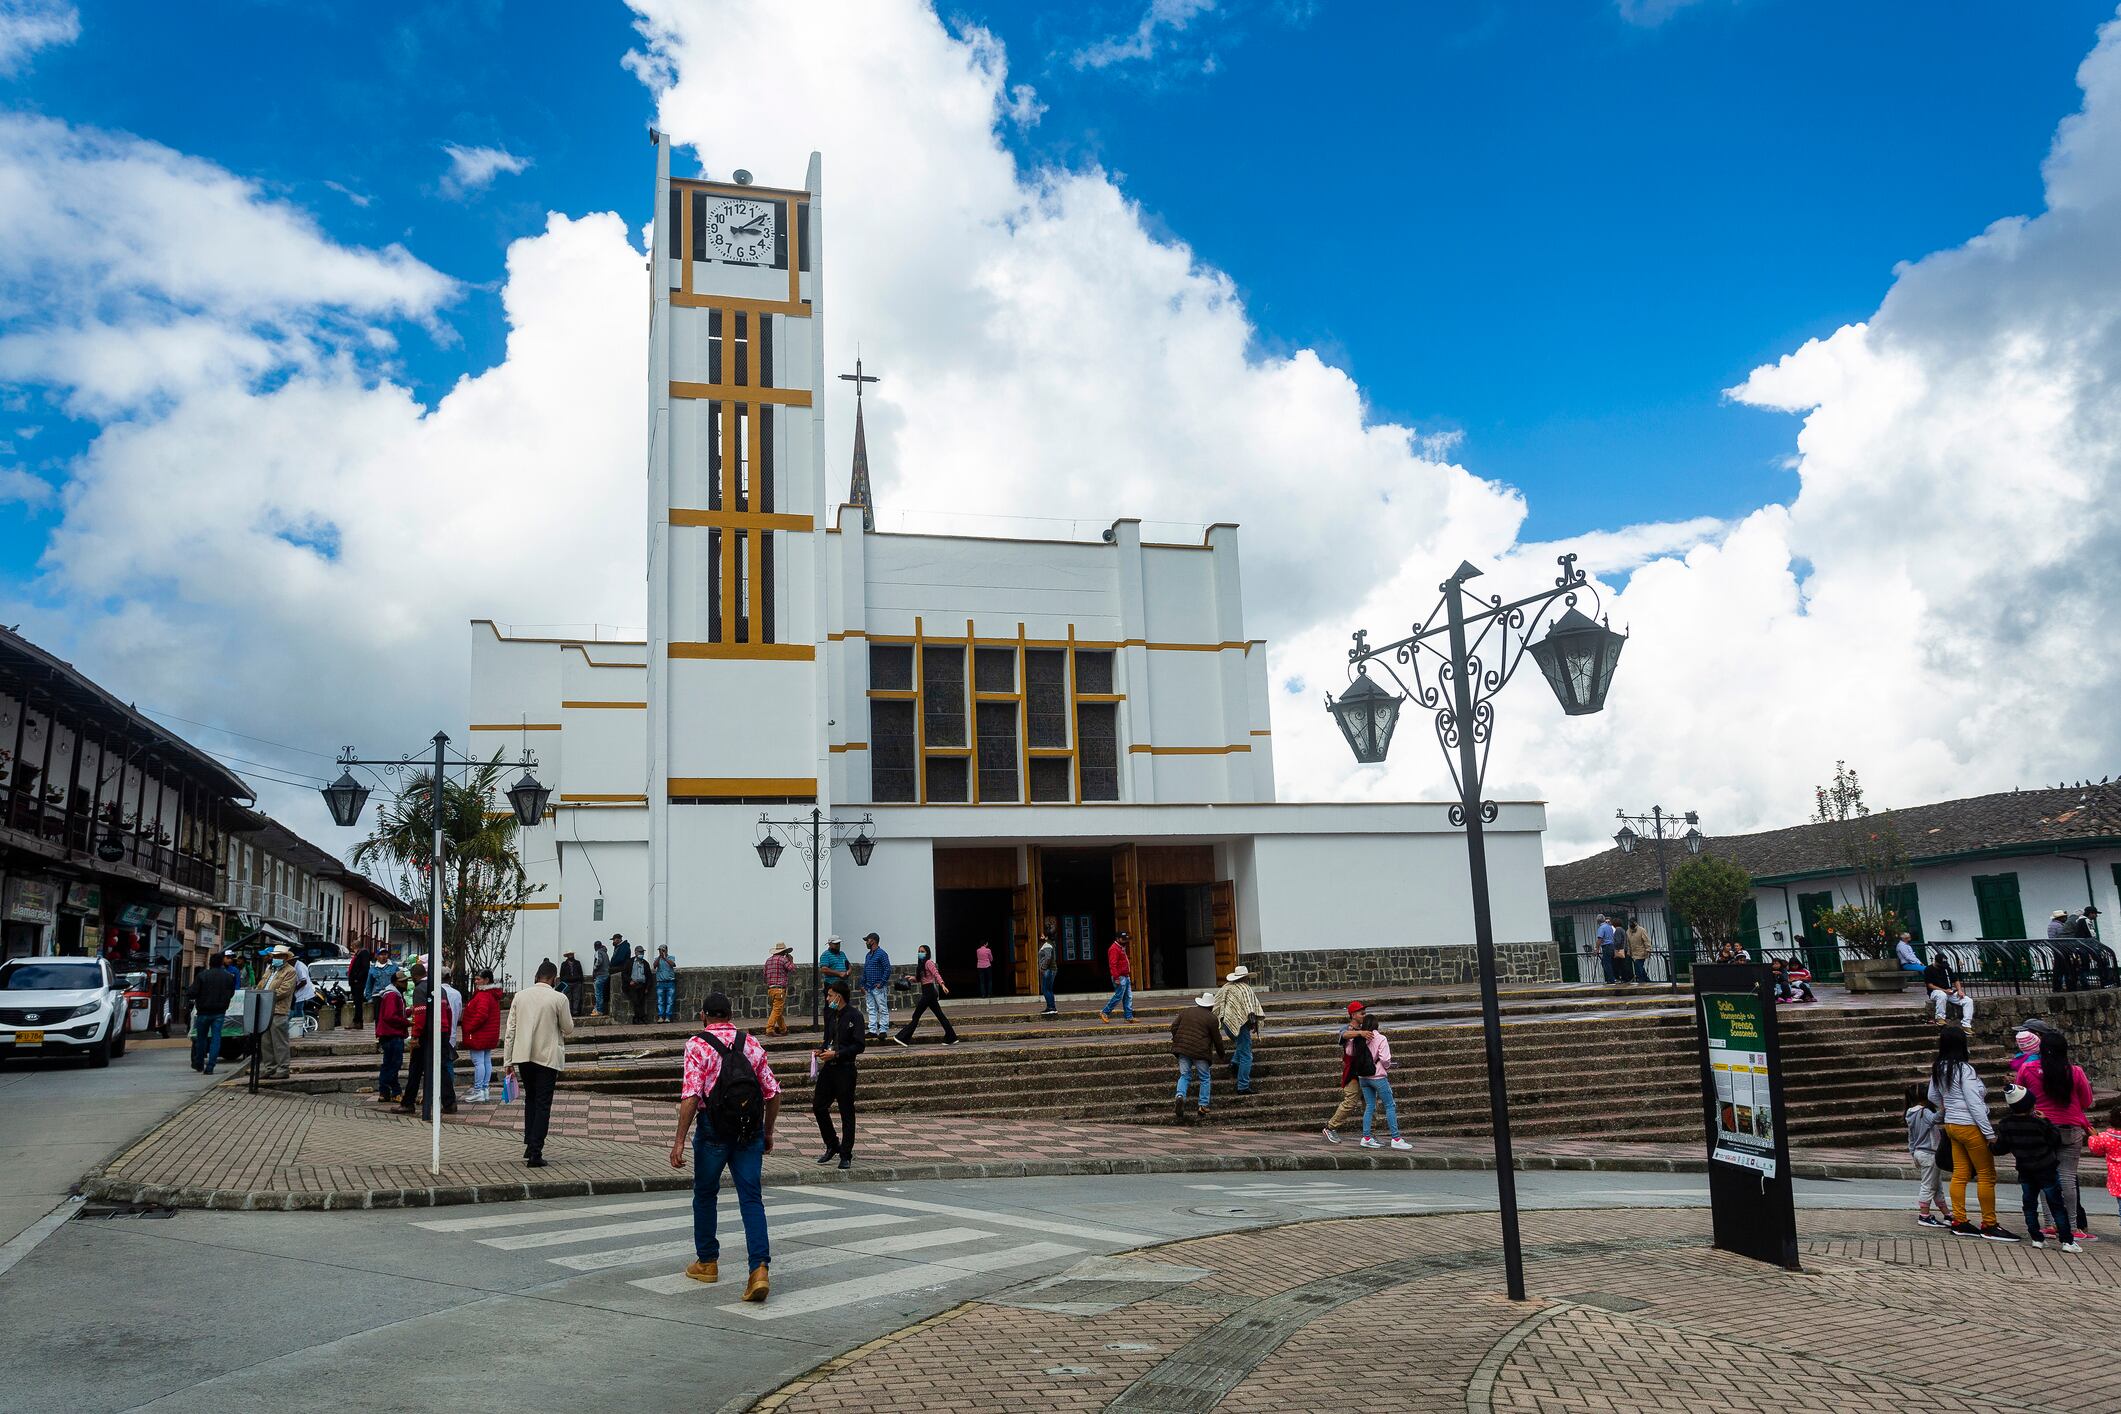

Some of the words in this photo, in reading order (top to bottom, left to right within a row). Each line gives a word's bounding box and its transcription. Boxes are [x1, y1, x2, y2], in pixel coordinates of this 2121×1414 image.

[724, 206, 733, 216] 11
[734, 204, 746, 214] 12
[749, 208, 754, 218] 1
[714, 213, 725, 224] 10
[757, 215, 765, 226] 2
[710, 224, 718, 233] 9
[763, 228, 770, 239] 3
[715, 234, 724, 245] 8
[757, 239, 766, 249] 4
[725, 243, 732, 253] 7
[736, 247, 744, 258] 6
[749, 245, 756, 256] 5
[1720, 1012, 1746, 1021] Homenaje
[1731, 1020, 1754, 1030] Prensa
